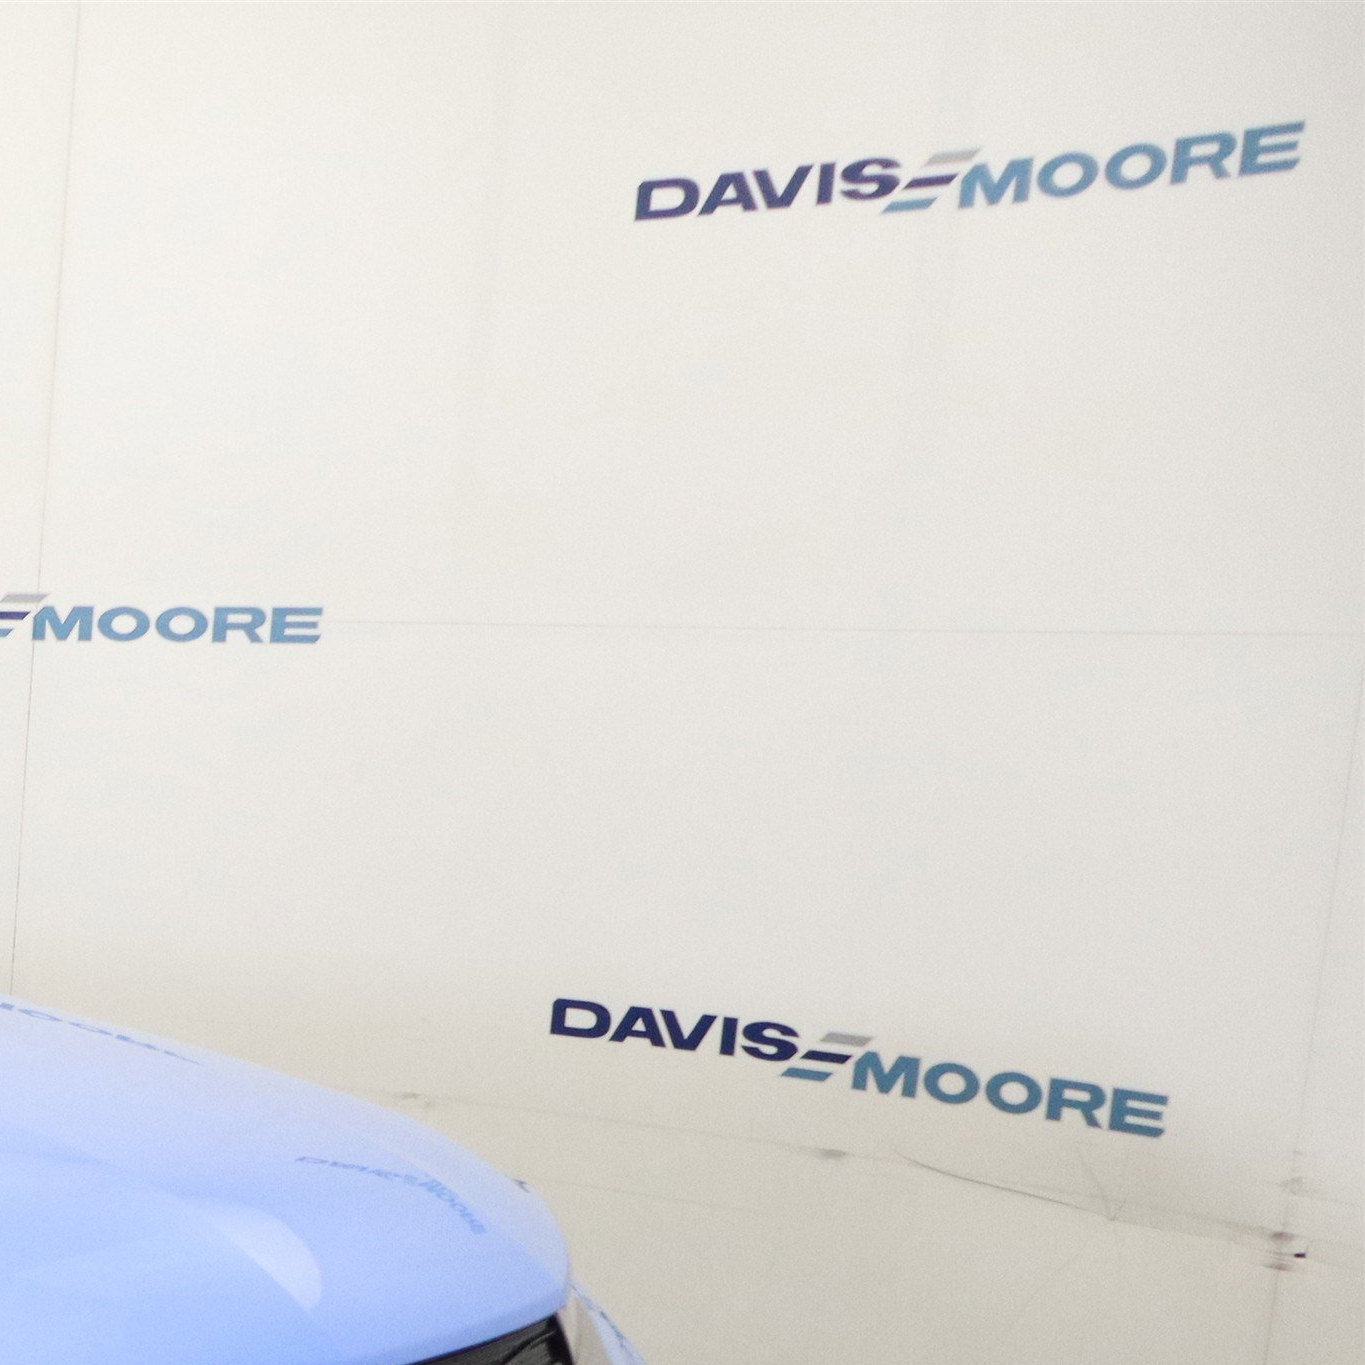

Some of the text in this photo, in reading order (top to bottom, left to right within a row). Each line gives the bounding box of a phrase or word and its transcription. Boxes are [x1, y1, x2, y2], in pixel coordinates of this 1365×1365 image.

[636, 122, 1303, 218] DAVIS MOORE
[32, 606, 323, 644] MOORE
[551, 998, 1168, 1137] DAVIS MOORE
